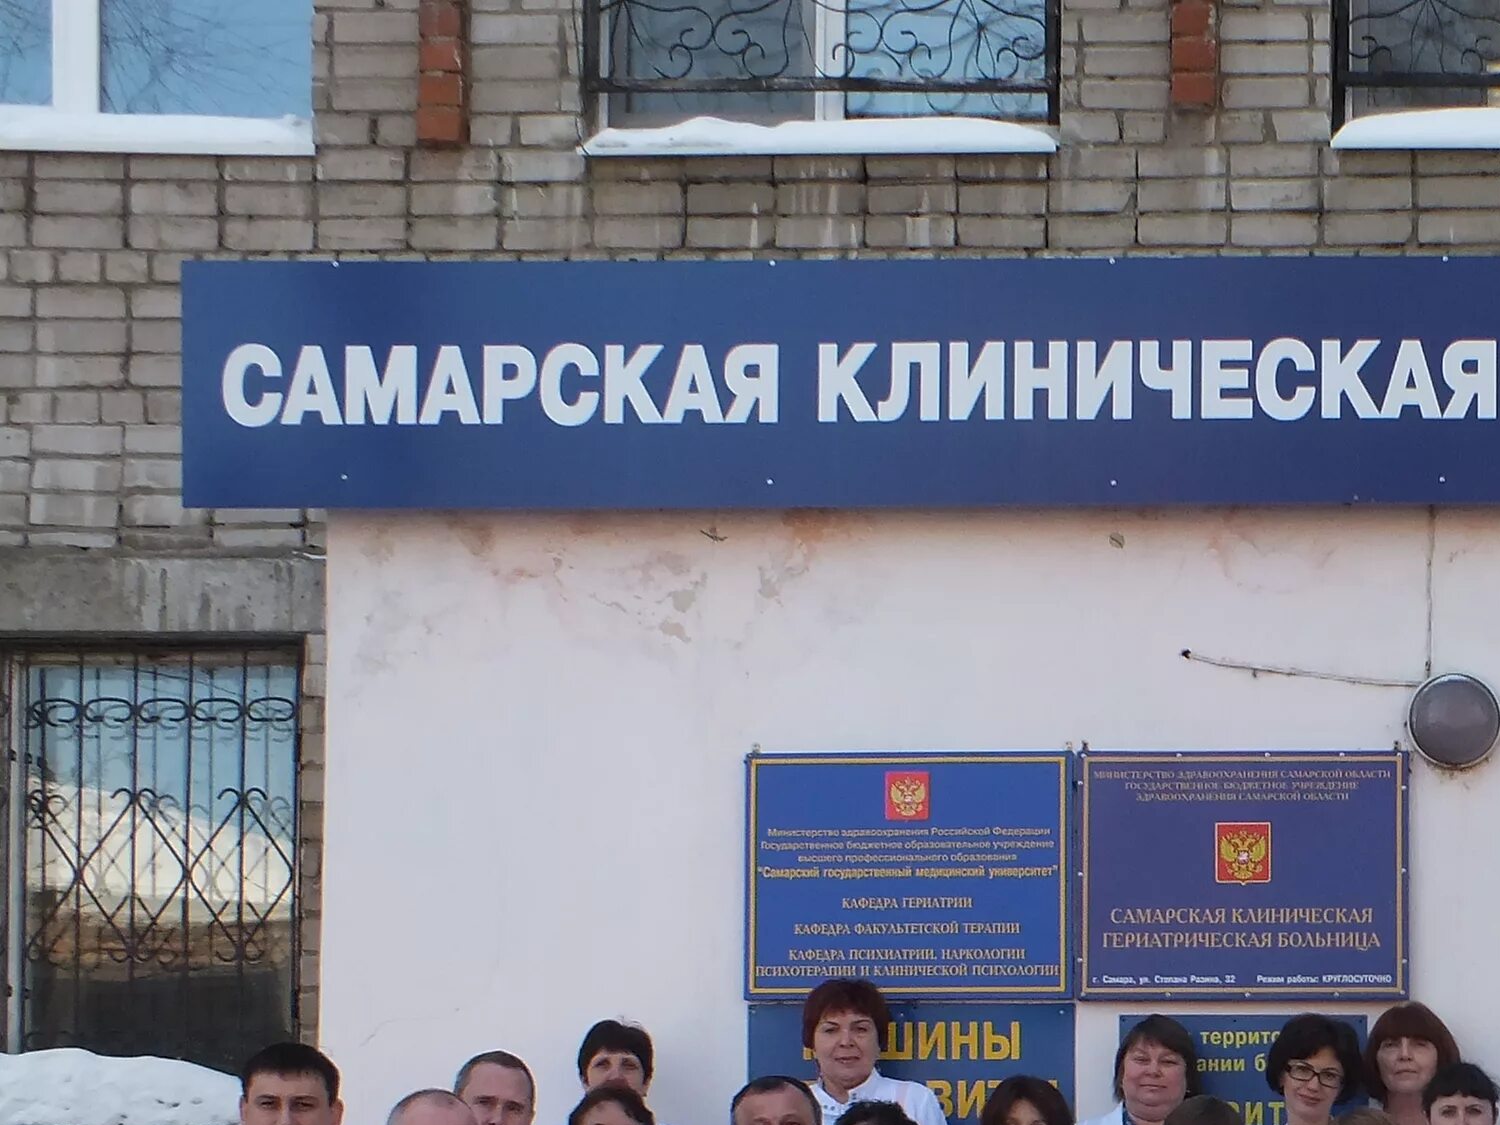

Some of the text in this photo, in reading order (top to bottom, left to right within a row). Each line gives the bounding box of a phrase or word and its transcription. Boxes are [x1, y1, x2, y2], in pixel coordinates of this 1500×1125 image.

[222, 342, 780, 428] САМАРСКАЯ
[816, 338, 1498, 424] КЛИНИЧЕСКАЯ
[1094, 768, 1391, 780] МИНИСТЕРСТВО ЗДРАВООХРАНЕНИЯ САМАРСКОЙ ОБЛАСТИ
[1125, 781, 1359, 791] ГОСУДАРСТВЕННОЕ БЮДЖЕТНОЕ УЧРЕЖДЕНИЕ
[1136, 791, 1349, 802] ЗДРАВООХРАНЕНИЯ САМАРСКОЙ ОБЛАСТИ
[767, 826, 1051, 838] Министерство здравоохранения Российской Федерации
[761, 839, 1055, 852] Государственное бюджетное образовательное учреждение
[797, 852, 1017, 864] высшего профессионального образования
[823, 865, 912, 879] государственный
[916, 864, 985, 879] медицинский
[842, 896, 973, 910] КАФЕДРА ГЕРИАТРИИ
[1110, 906, 1373, 924] САМАРСКАЯ КЛИНИЧЕСКАЯ
[793, 920, 1020, 936] КАФЕДРА ФАКУЛЬТЕТСКОЙ ТЕРАПИИ
[1102, 930, 1381, 951] ГЕРИАТРИЧЕСКАЯ БОЛЬНИЦА
[789, 949, 846, 962] КАФЕДРА
[942, 948, 1026, 961] НАРКОЛОГИИ
[755, 962, 1060, 977] ПСИХОТЕРАПИИ И КЛИНИЧЕСКОЙ ПСИХОЛОГИИ
[1103, 974, 1136, 985] Самара,
[1154, 974, 1188, 984] Степана
[1225, 974, 1236, 984] 32
[1256, 974, 1285, 984] Режим
[1322, 974, 1392, 984] КРУГЛОСУТОЧНО
[803, 1021, 1021, 1061] ШИНЫ
